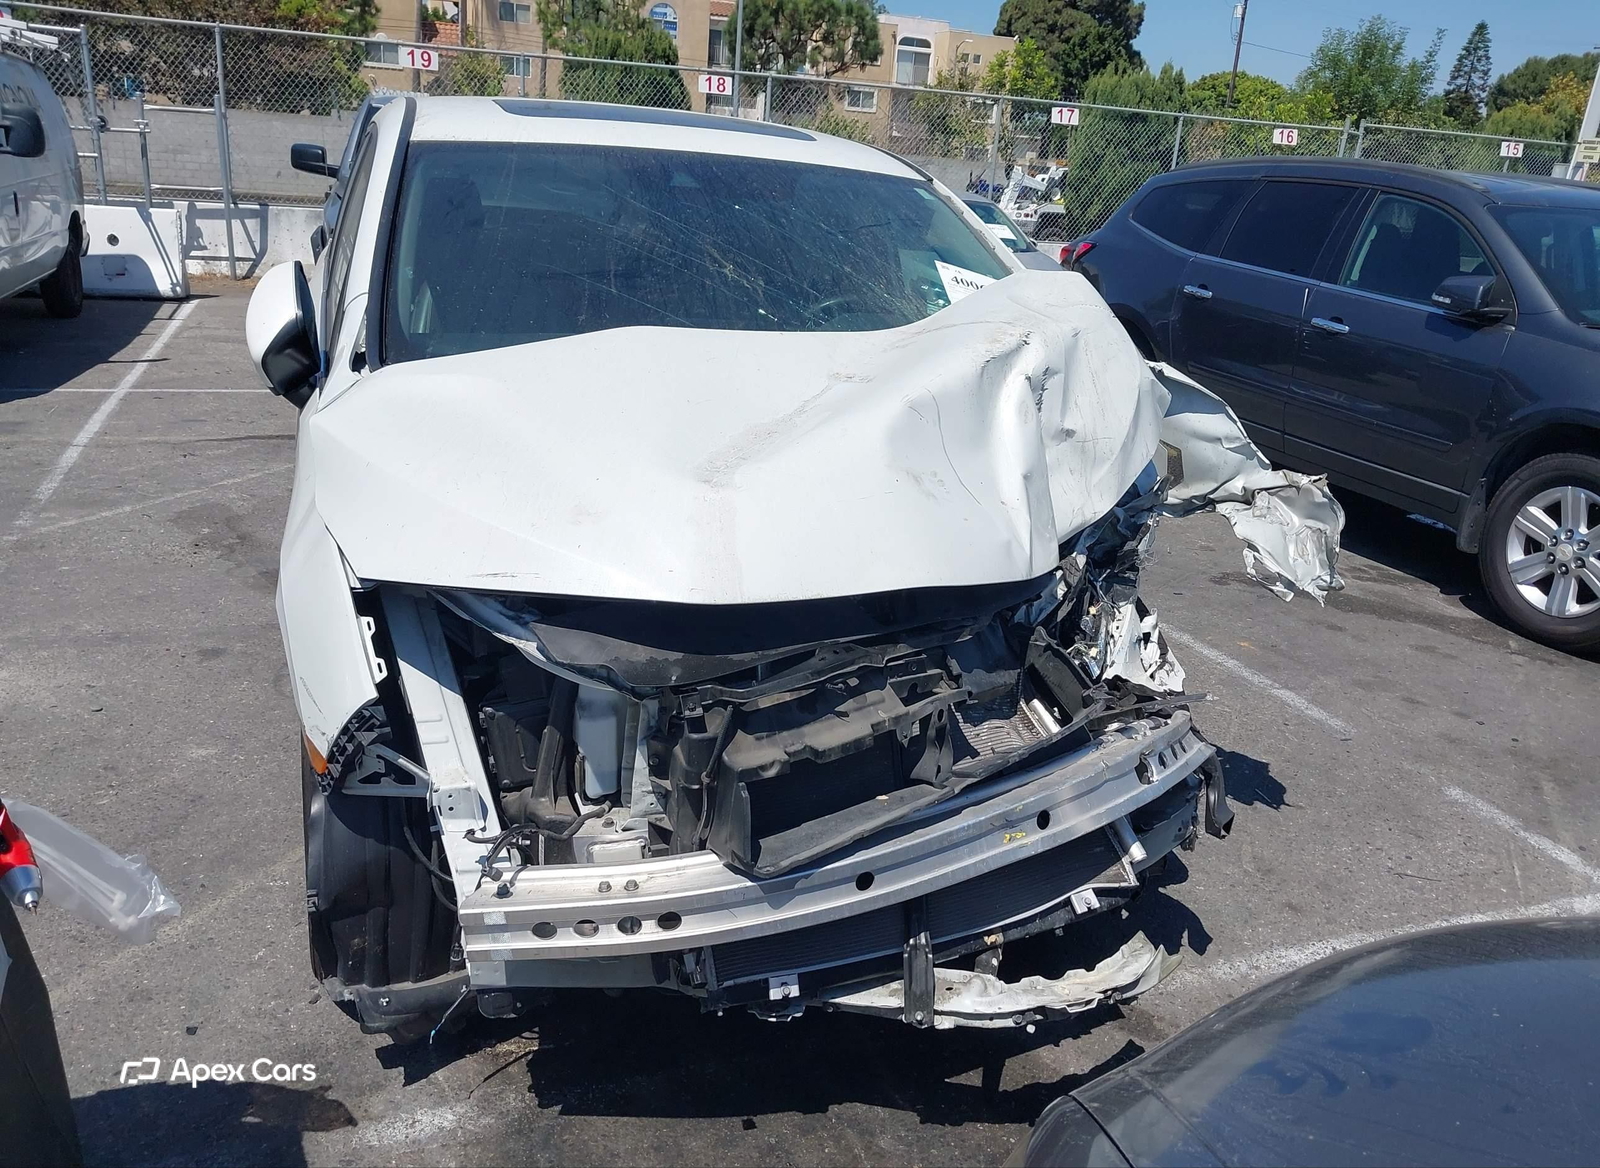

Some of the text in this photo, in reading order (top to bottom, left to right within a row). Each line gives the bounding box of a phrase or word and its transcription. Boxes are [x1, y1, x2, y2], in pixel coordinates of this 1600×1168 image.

[407, 49, 432, 68] 19
[705, 76, 726, 93] 18
[1057, 108, 1075, 124] 17
[1279, 129, 1294, 144] 16
[1505, 143, 1520, 156] 15
